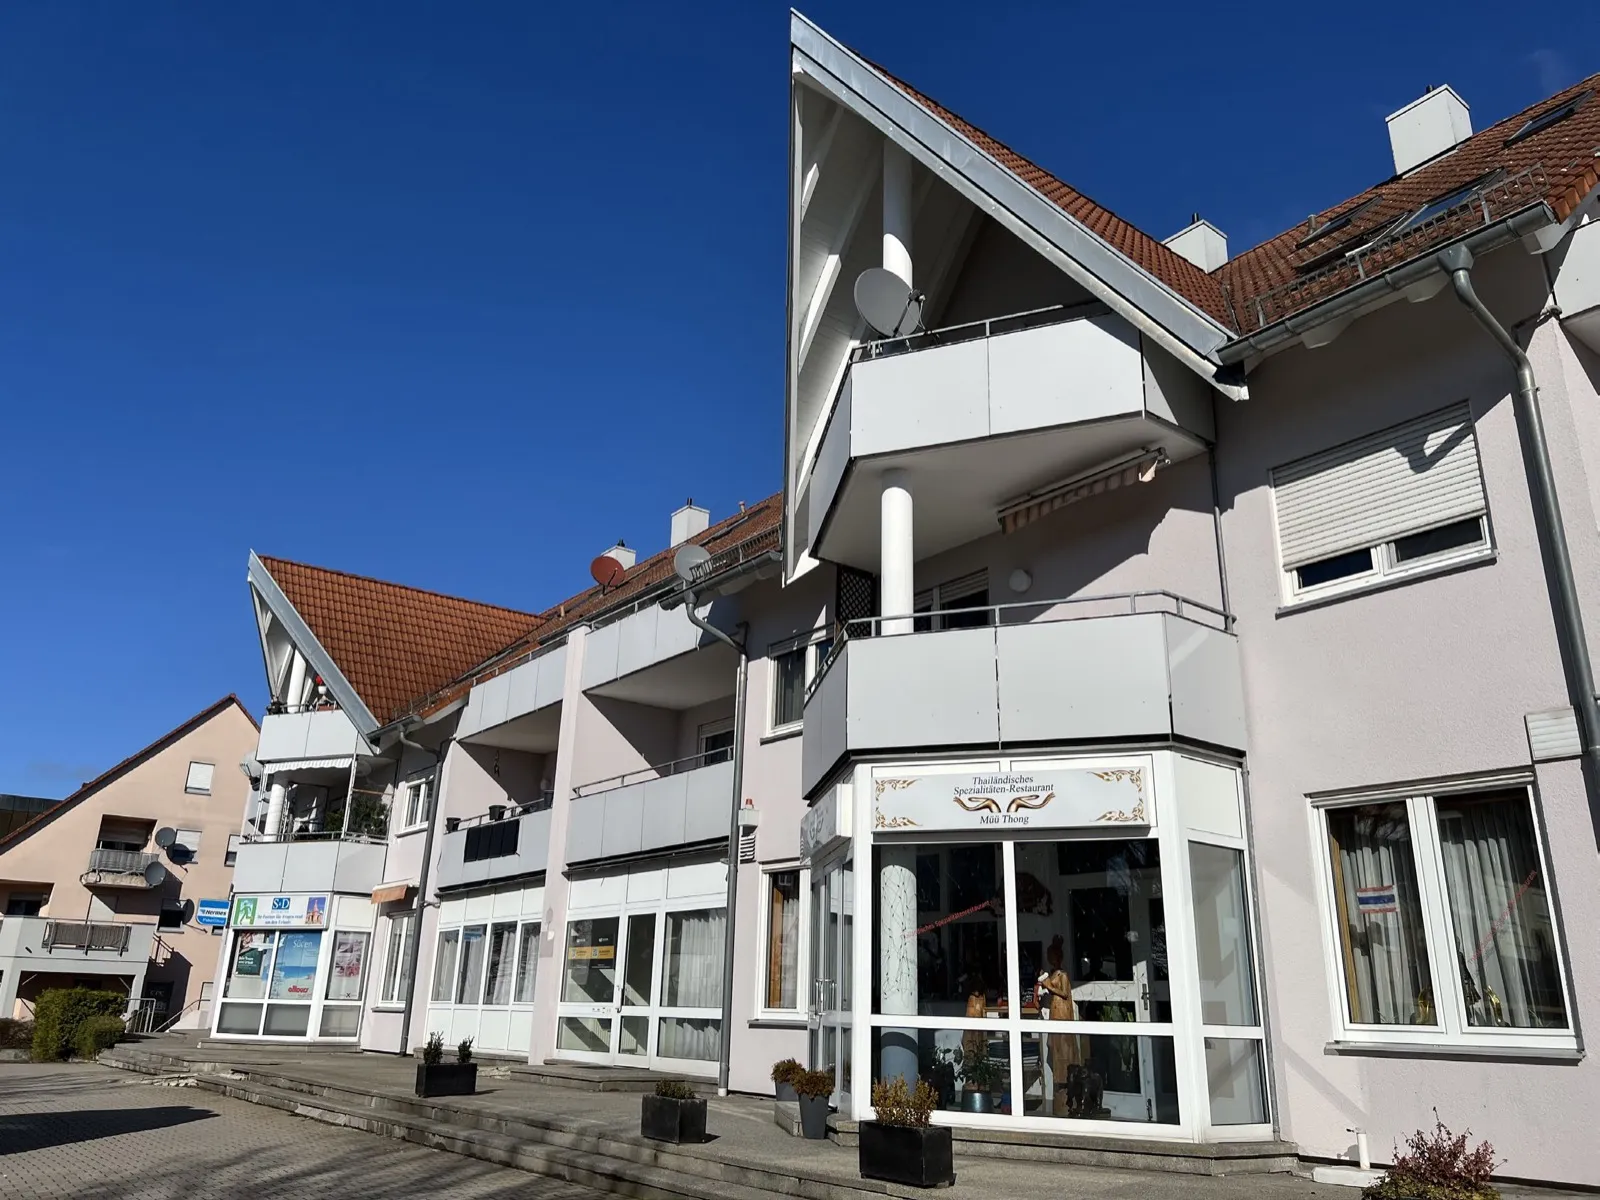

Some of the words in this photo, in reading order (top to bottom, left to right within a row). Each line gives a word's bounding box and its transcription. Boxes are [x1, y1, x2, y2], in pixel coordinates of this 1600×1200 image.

[972, 775, 1034, 785] Thailändisches
[953, 784, 1054, 797] Spezialitäten-Restaurant
[979, 815, 1000, 824] Müü
[1002, 814, 1029, 825] Thong
